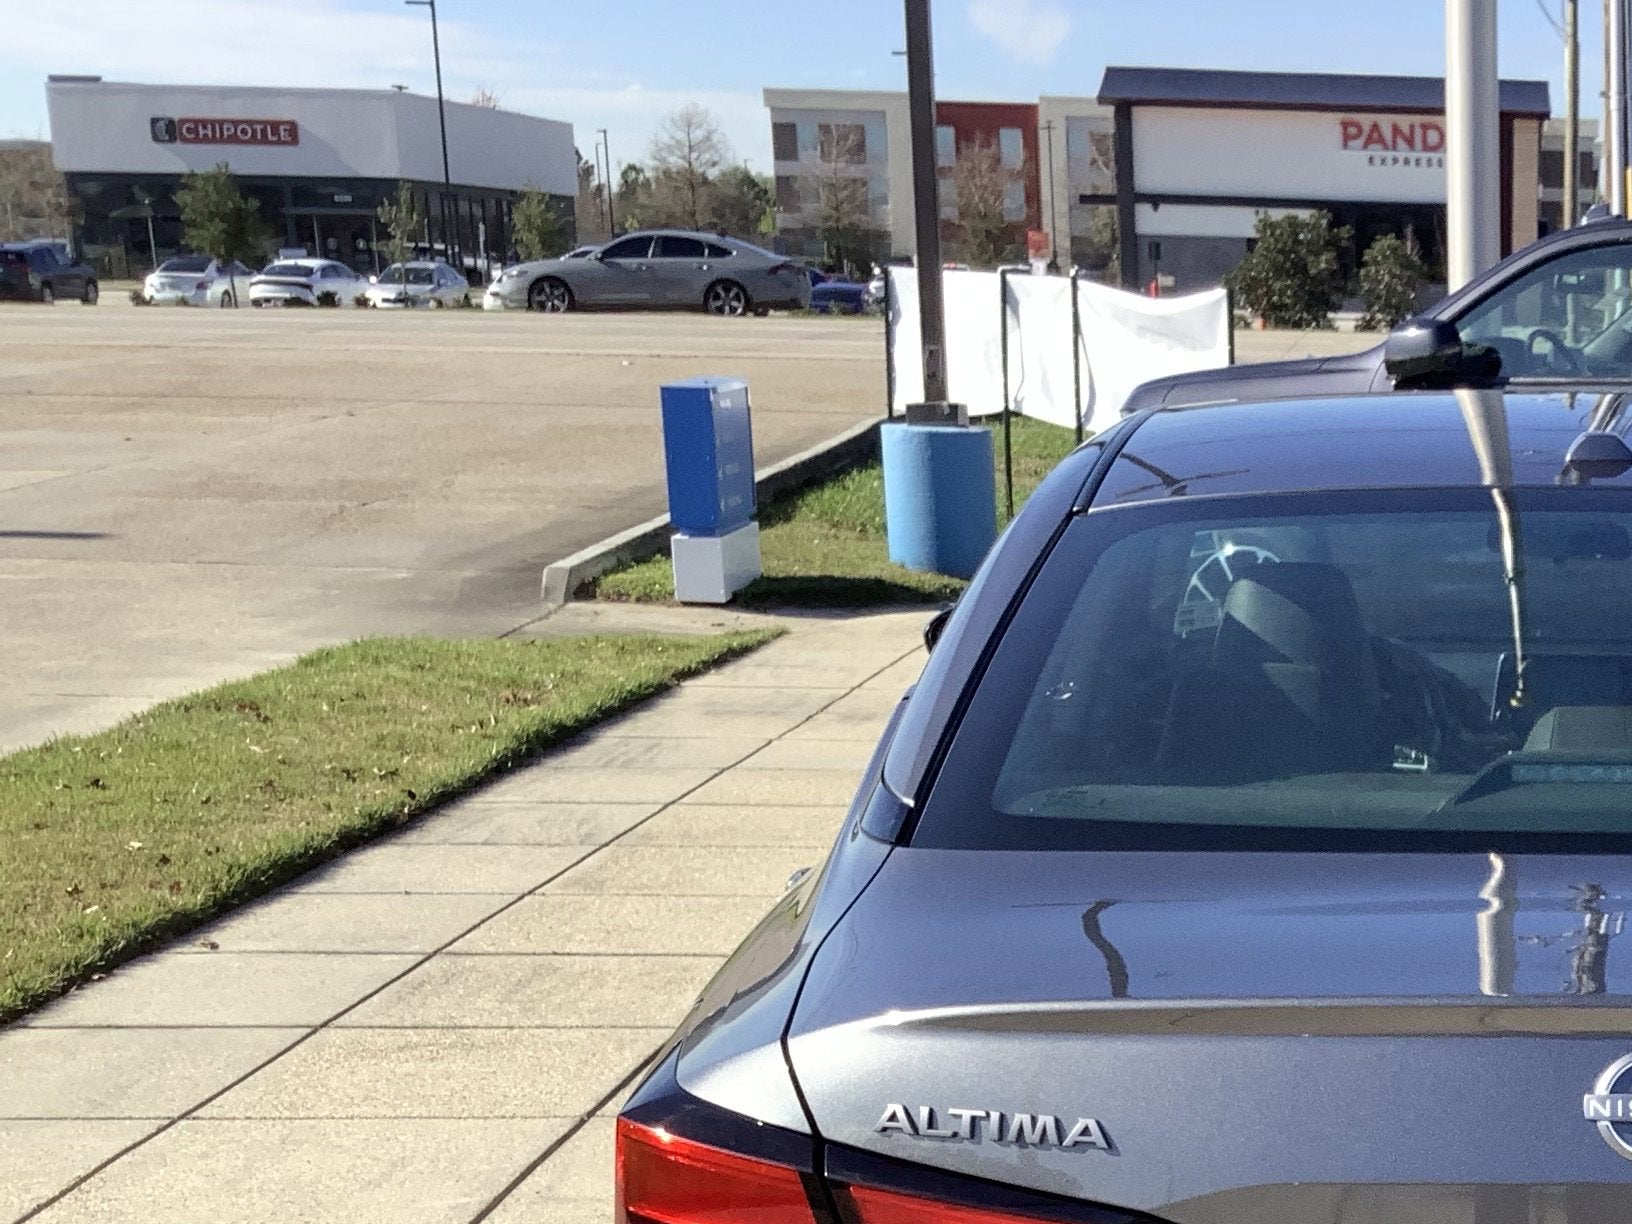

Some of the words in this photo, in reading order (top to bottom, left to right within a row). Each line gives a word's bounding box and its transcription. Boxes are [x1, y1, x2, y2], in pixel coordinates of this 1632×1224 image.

[182, 122, 292, 141] CHIPOTLE
[1341, 119, 1446, 152] PAND
[873, 1103, 1114, 1149] ALTIMA
